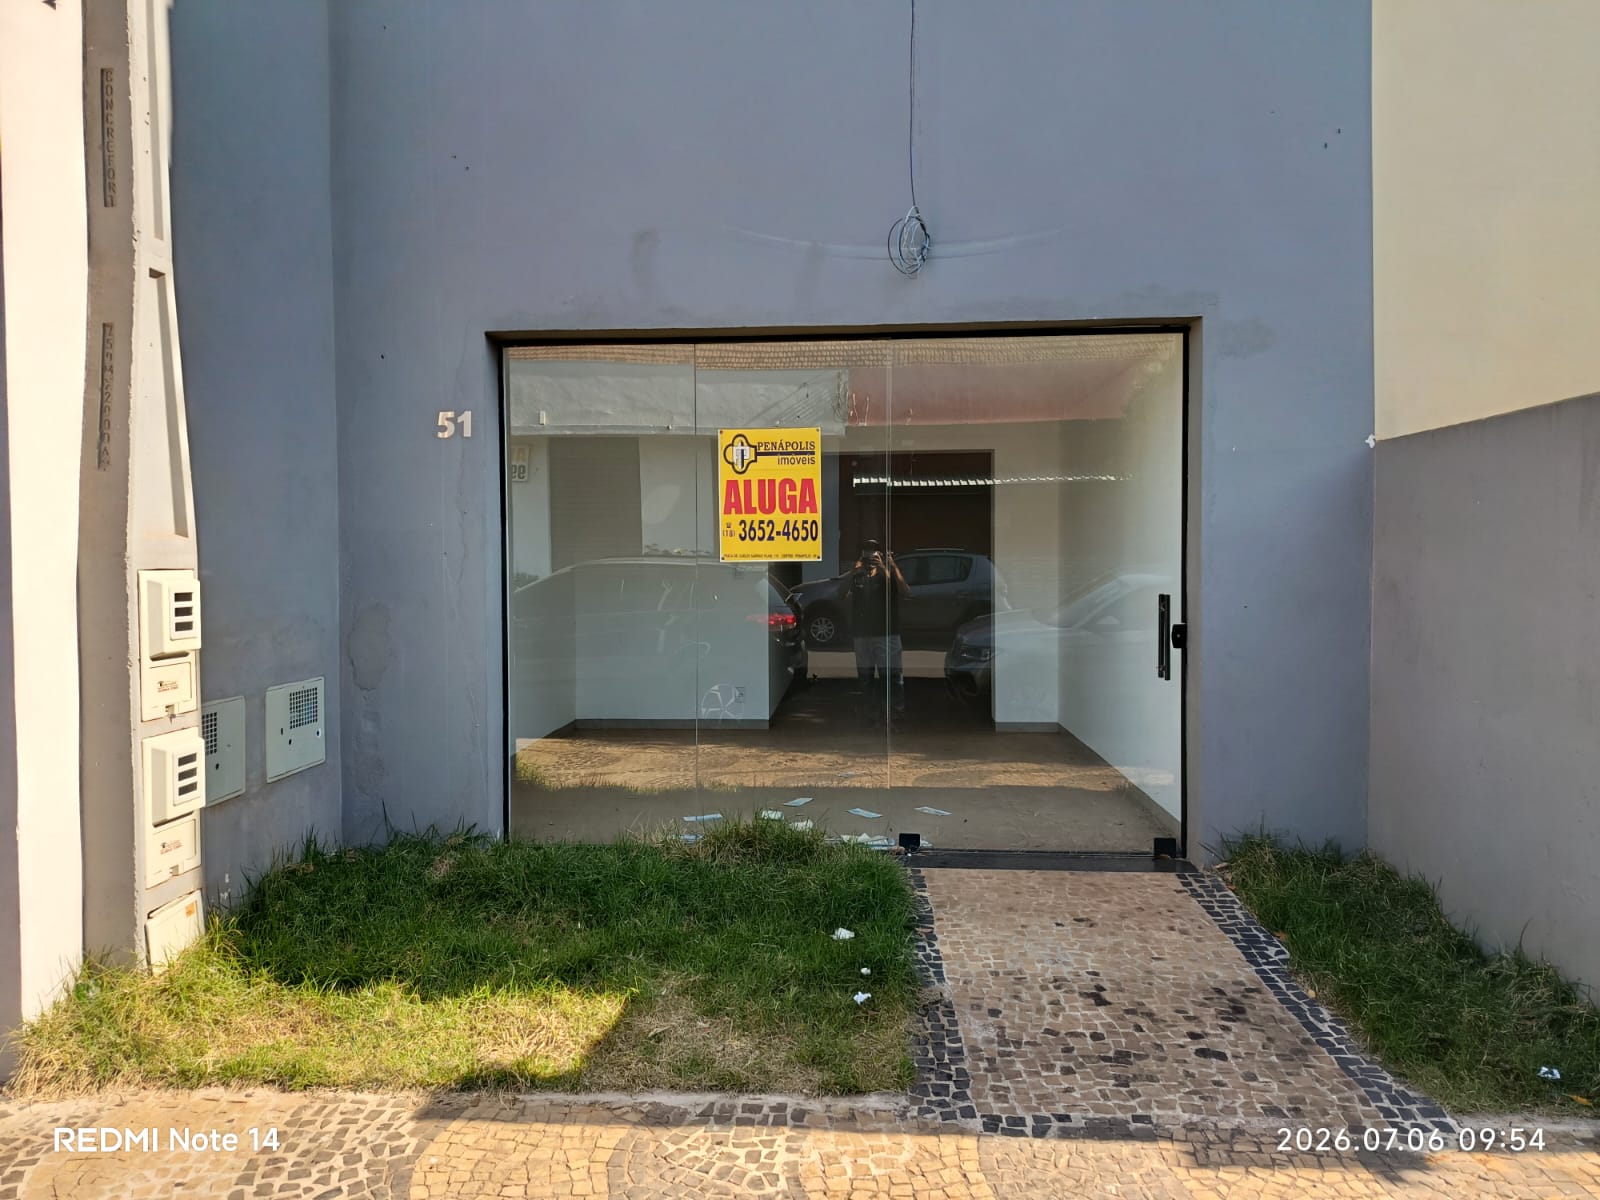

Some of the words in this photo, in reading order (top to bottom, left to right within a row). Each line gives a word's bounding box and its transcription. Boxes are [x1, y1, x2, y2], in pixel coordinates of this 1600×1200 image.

[437, 410, 472, 439] 51
[757, 439, 816, 451] PENÁPOLIS
[777, 454, 816, 465] imóveis
[723, 477, 818, 515] ALUGA
[738, 519, 819, 542] 3652-4650
